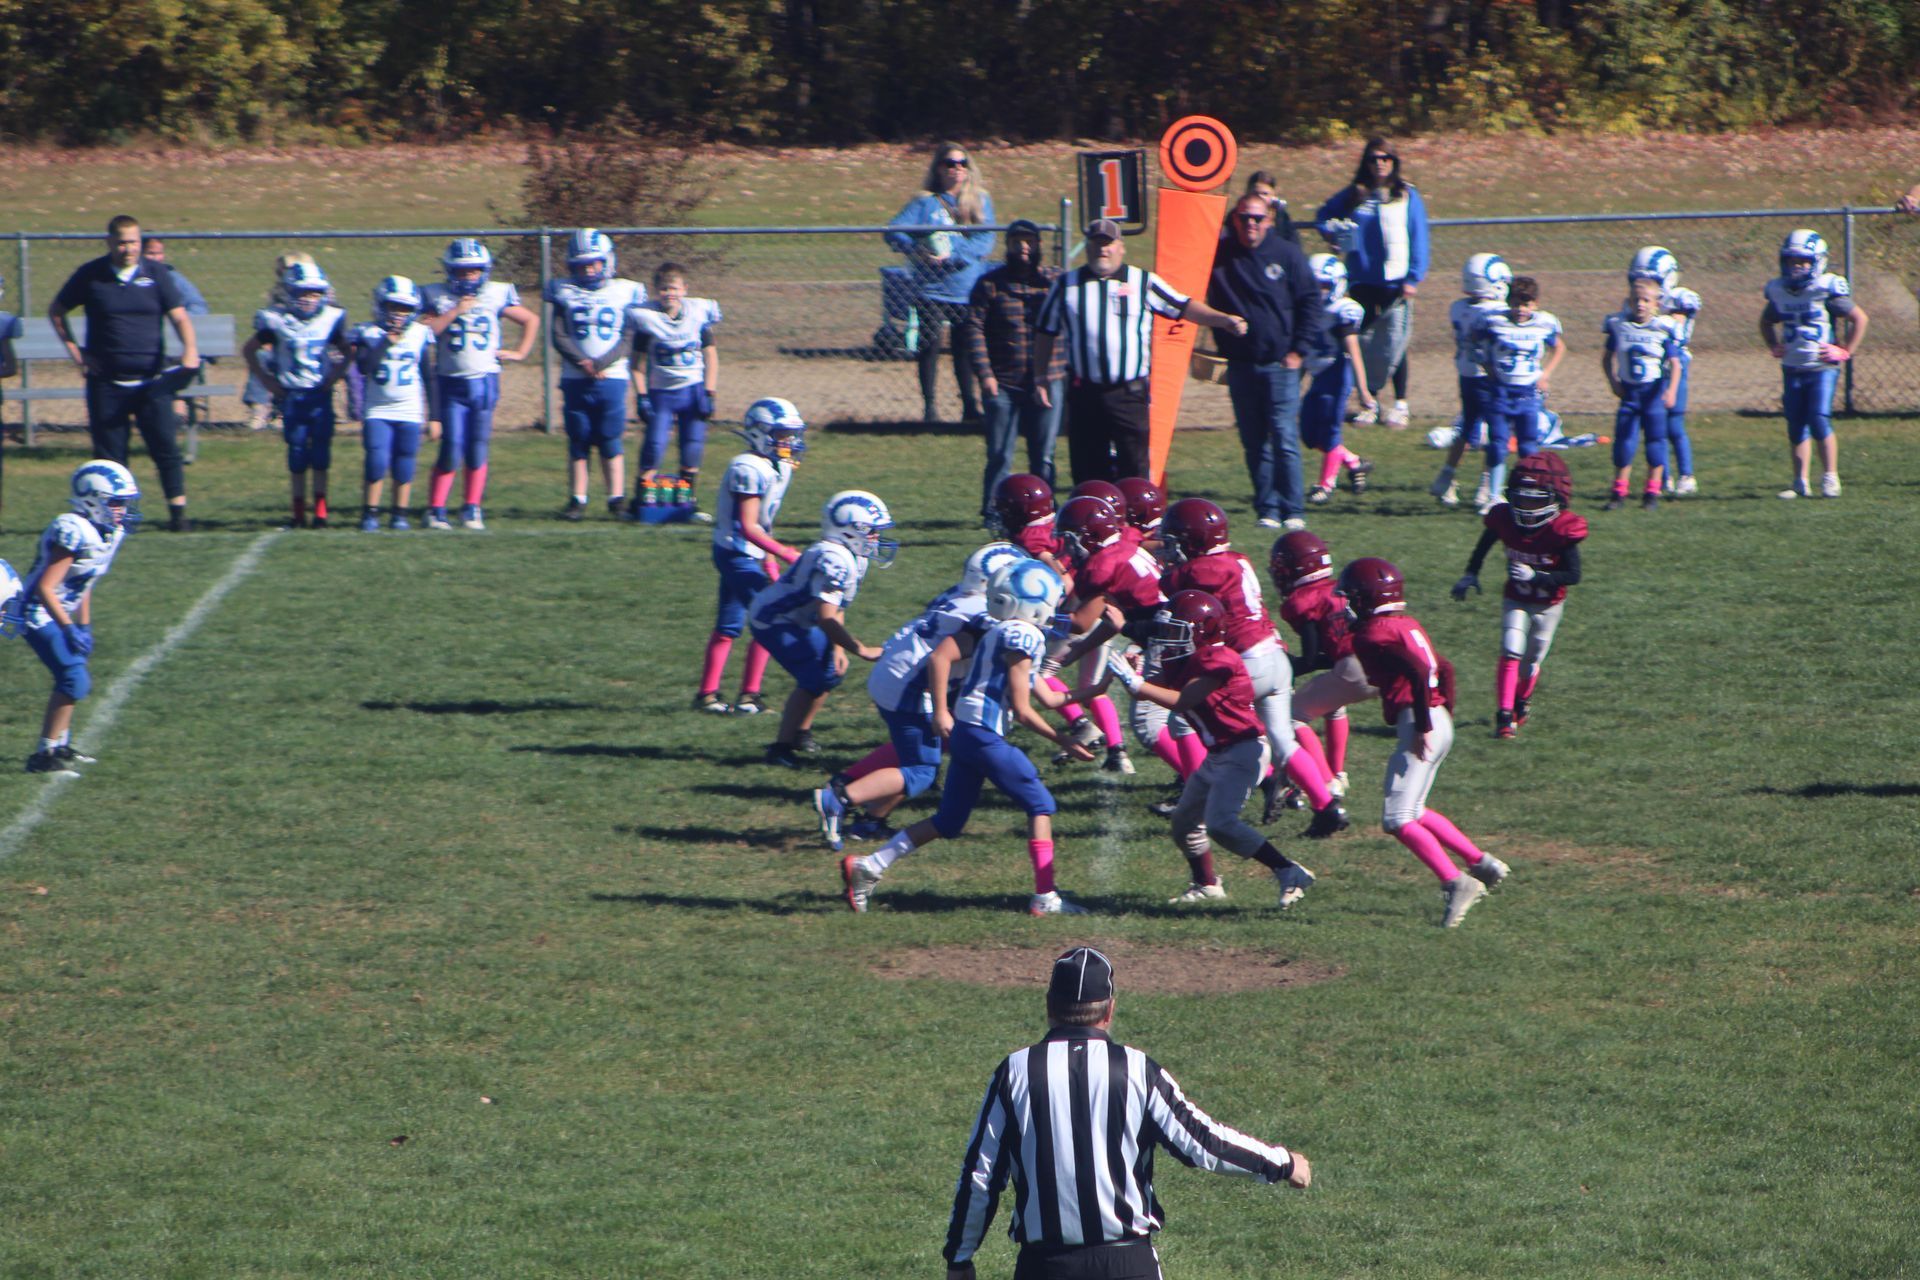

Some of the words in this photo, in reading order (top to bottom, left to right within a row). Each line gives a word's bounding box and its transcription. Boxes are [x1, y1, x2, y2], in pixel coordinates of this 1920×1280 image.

[1099, 159, 1128, 219] 1
[1629, 344, 1646, 380] 6
[1010, 630, 1034, 652] 20
